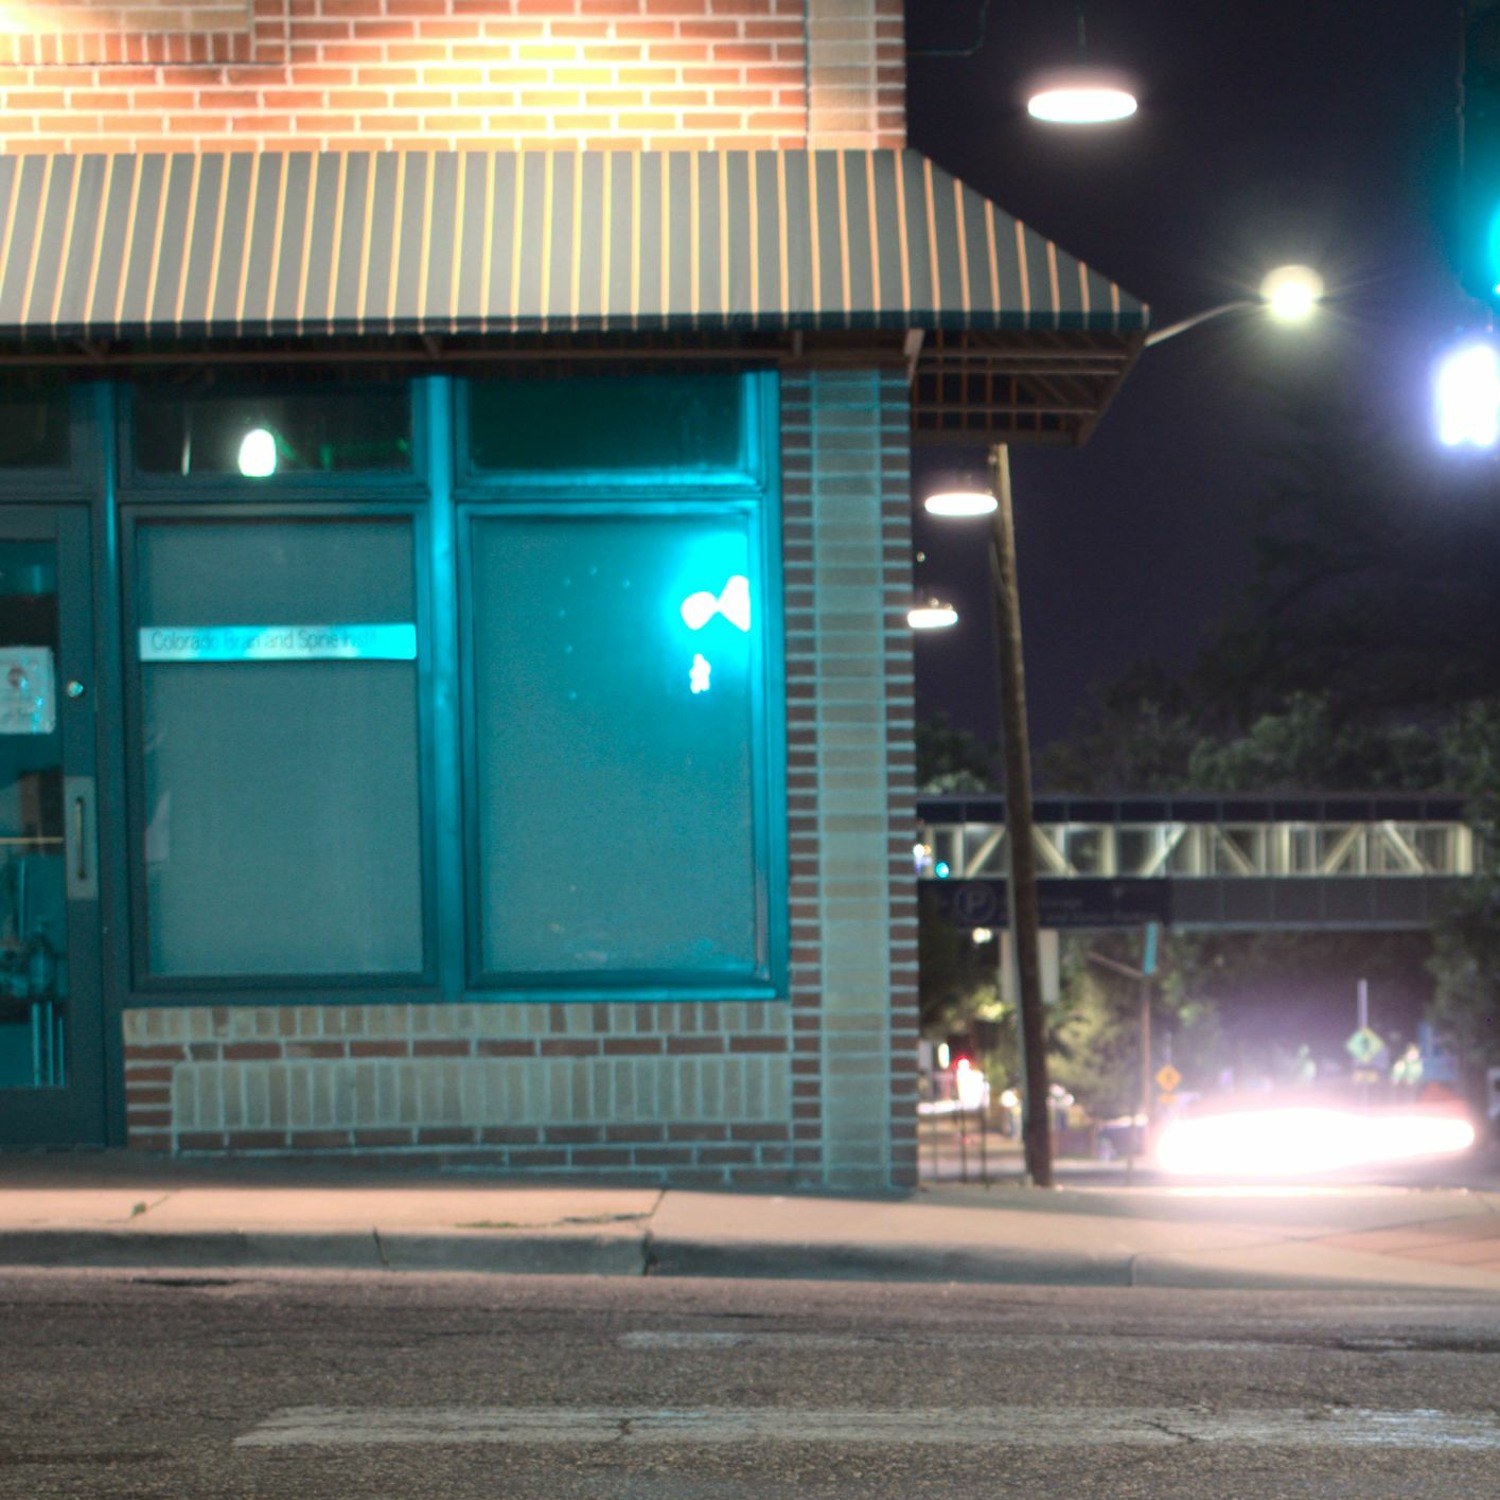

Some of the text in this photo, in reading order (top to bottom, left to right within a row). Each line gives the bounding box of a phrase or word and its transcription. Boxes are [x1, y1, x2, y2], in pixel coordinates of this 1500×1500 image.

[151, 630, 219, 651] Colorado
[265, 629, 293, 648] and
[299, 628, 338, 652] Spine
